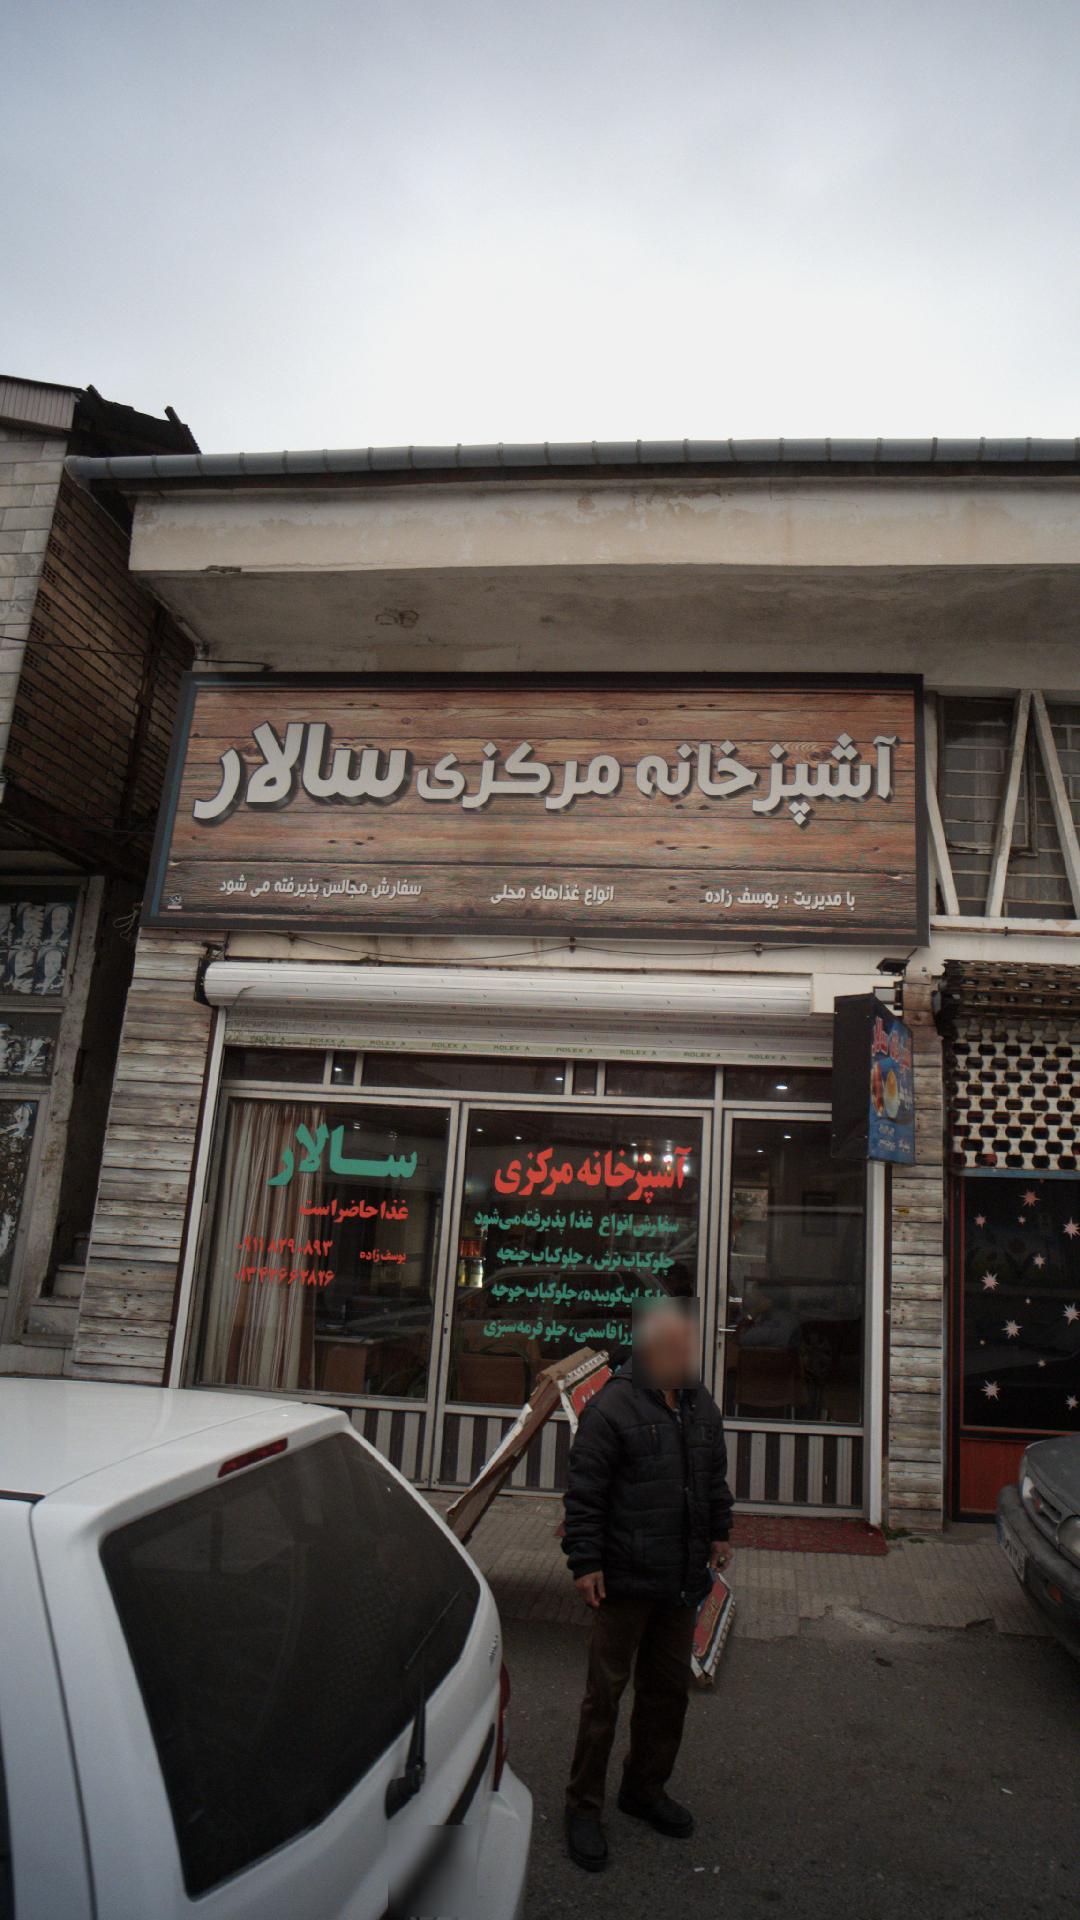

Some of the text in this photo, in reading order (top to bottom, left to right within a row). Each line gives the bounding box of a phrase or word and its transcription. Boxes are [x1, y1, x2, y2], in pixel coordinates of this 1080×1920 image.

[193, 722, 896, 824] آشپزخانه مرکزی سالار
[219, 874, 421, 899] سفارش مجالس پذیرفته می شود
[490, 884, 615, 906] انواع غذاهای محلی
[704, 888, 733, 908] زاده
[737, 887, 780, 909] یوسف
[793, 891, 843, 910] مدیریت
[846, 891, 856, 912] با
[266, 1122, 418, 1186] سالار
[494, 1147, 574, 1196] مرکزی
[298, 1198, 409, 1223] غذا حاضر است
[569, 1209, 593, 1229] غذا
[598, 1213, 634, 1237] انواع
[632, 1214, 680, 1238] سفارش
[359, 1248, 407, 1265] یوسف زاده
